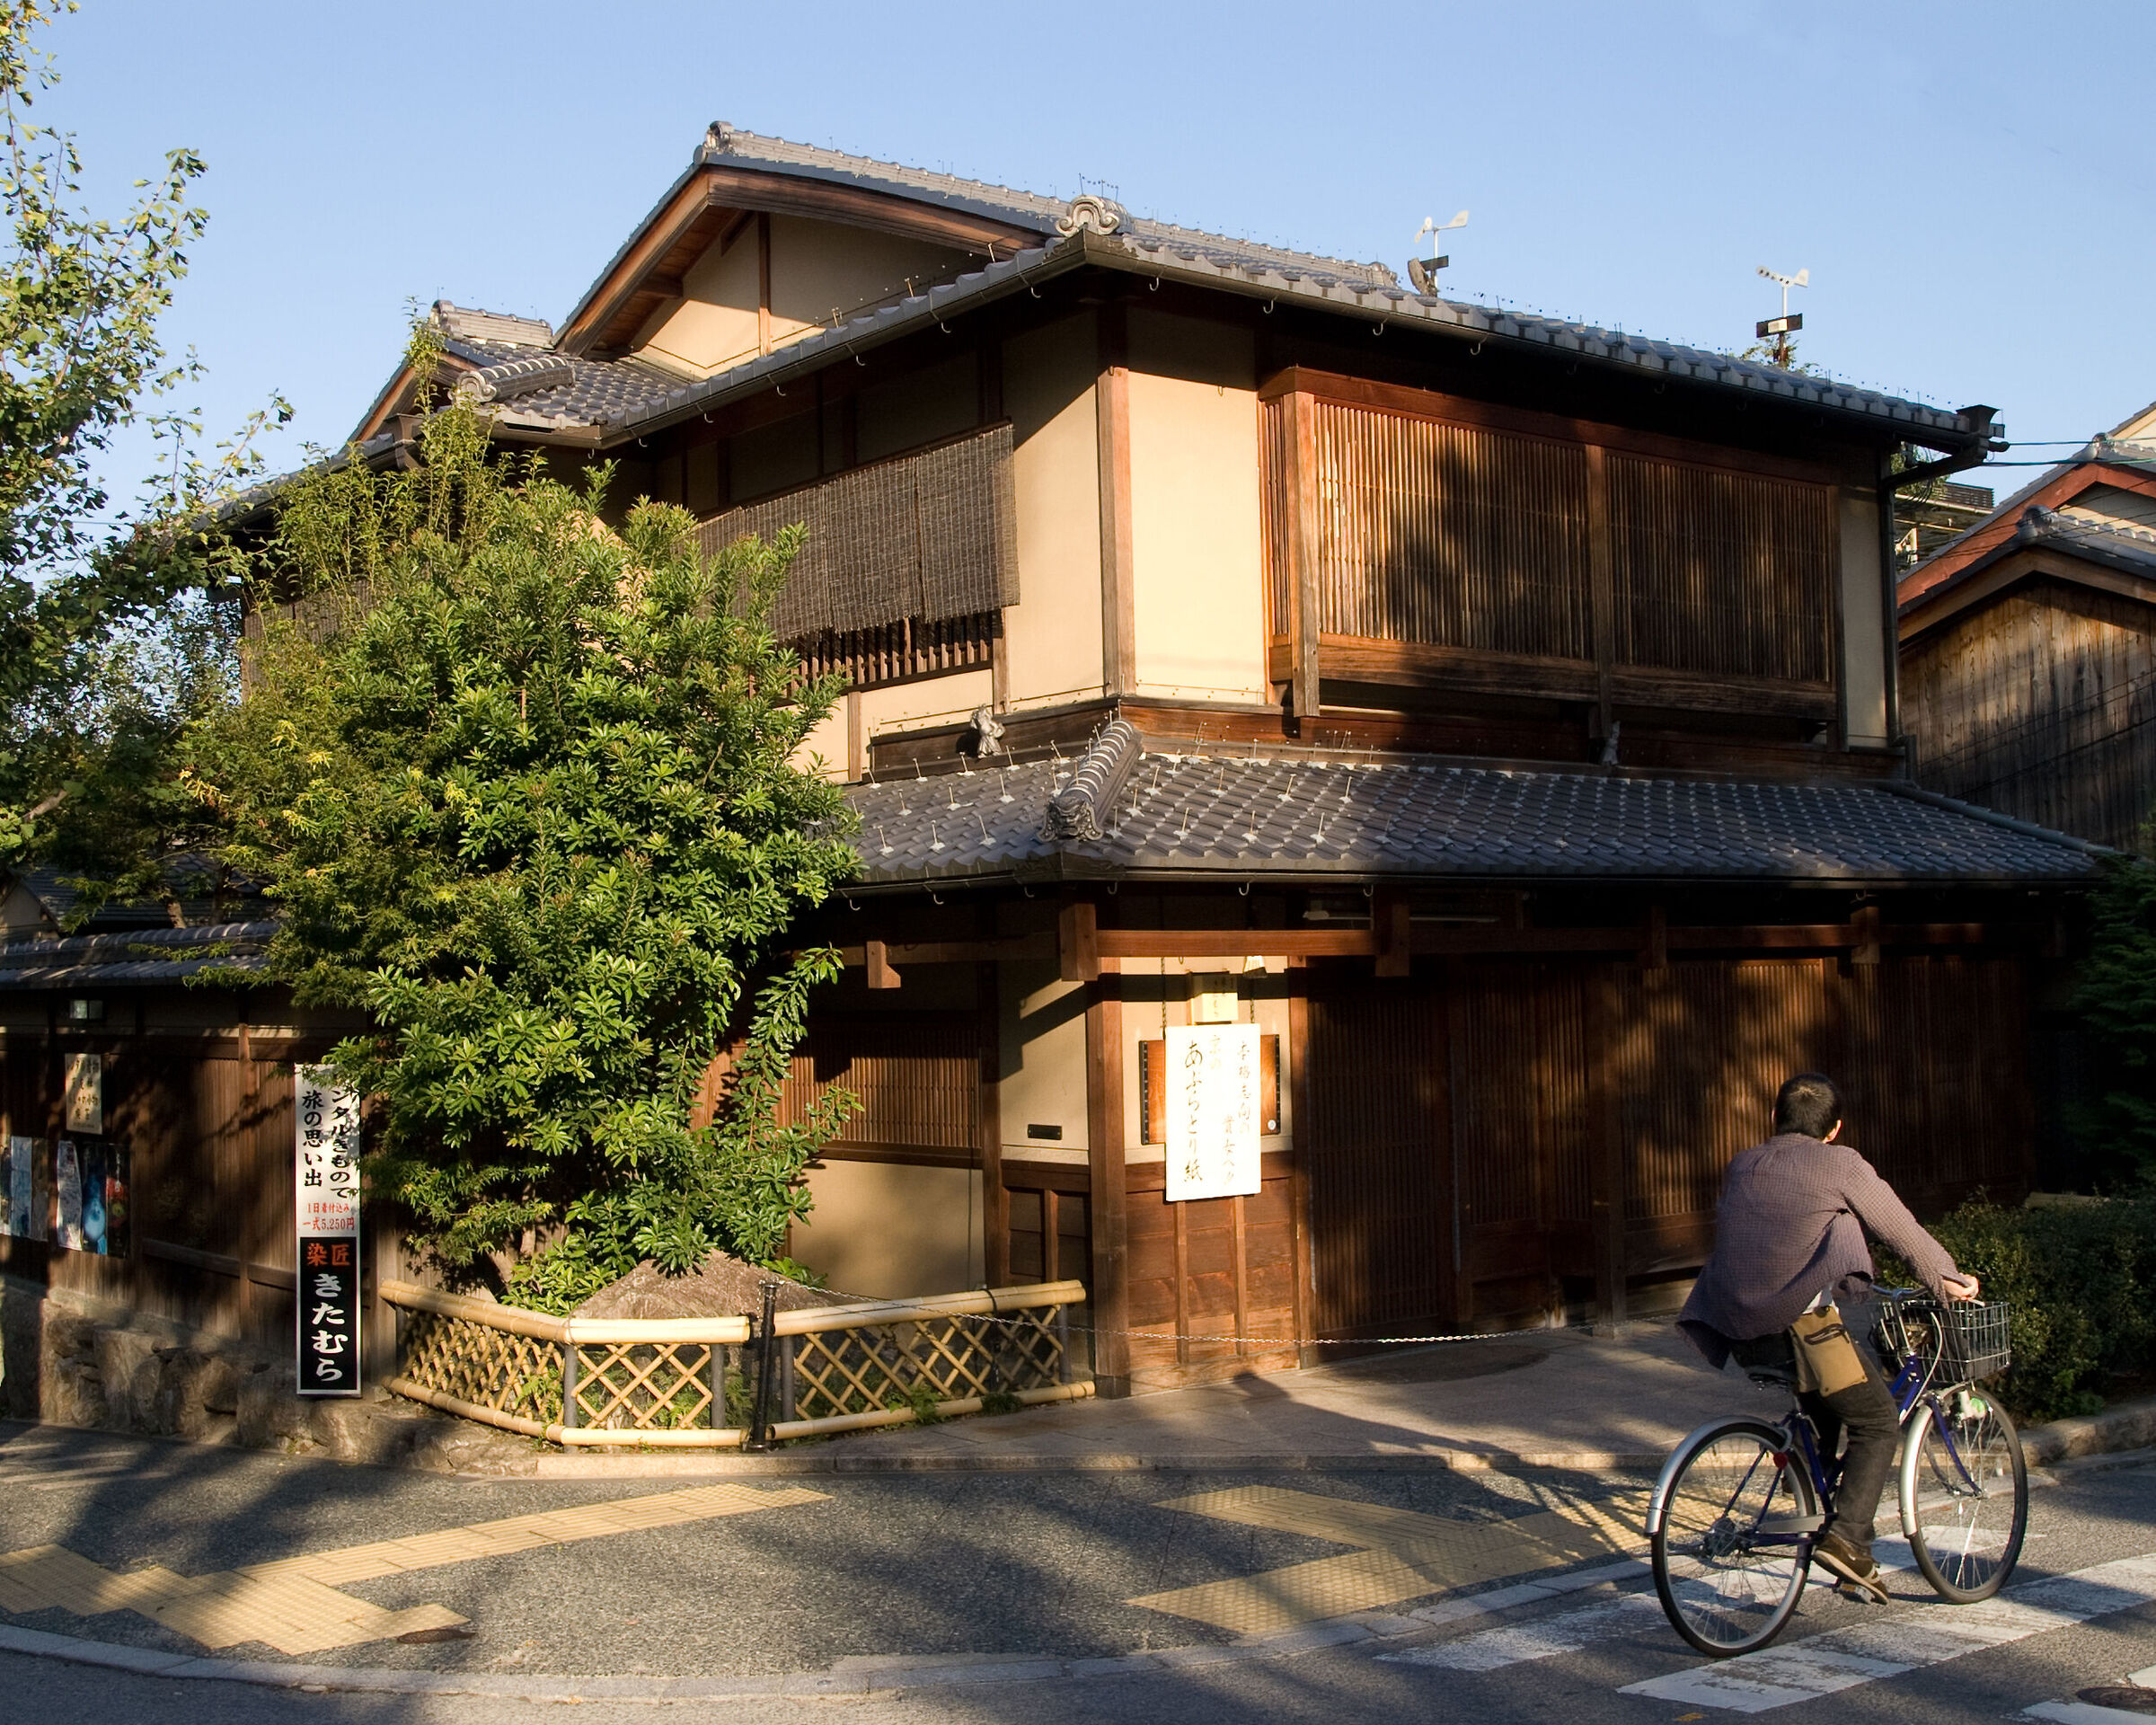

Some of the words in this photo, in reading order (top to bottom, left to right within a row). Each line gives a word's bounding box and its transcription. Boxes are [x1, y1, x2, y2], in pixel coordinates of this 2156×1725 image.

[302, 1090, 324, 1188] 旅の思い出
[1183, 1039, 1204, 1184] あぶらとり紙
[305, 1242, 351, 1268] 染匠
[307, 1201, 350, 1214] 1日着付込み
[311, 1273, 349, 1383] きたむら
